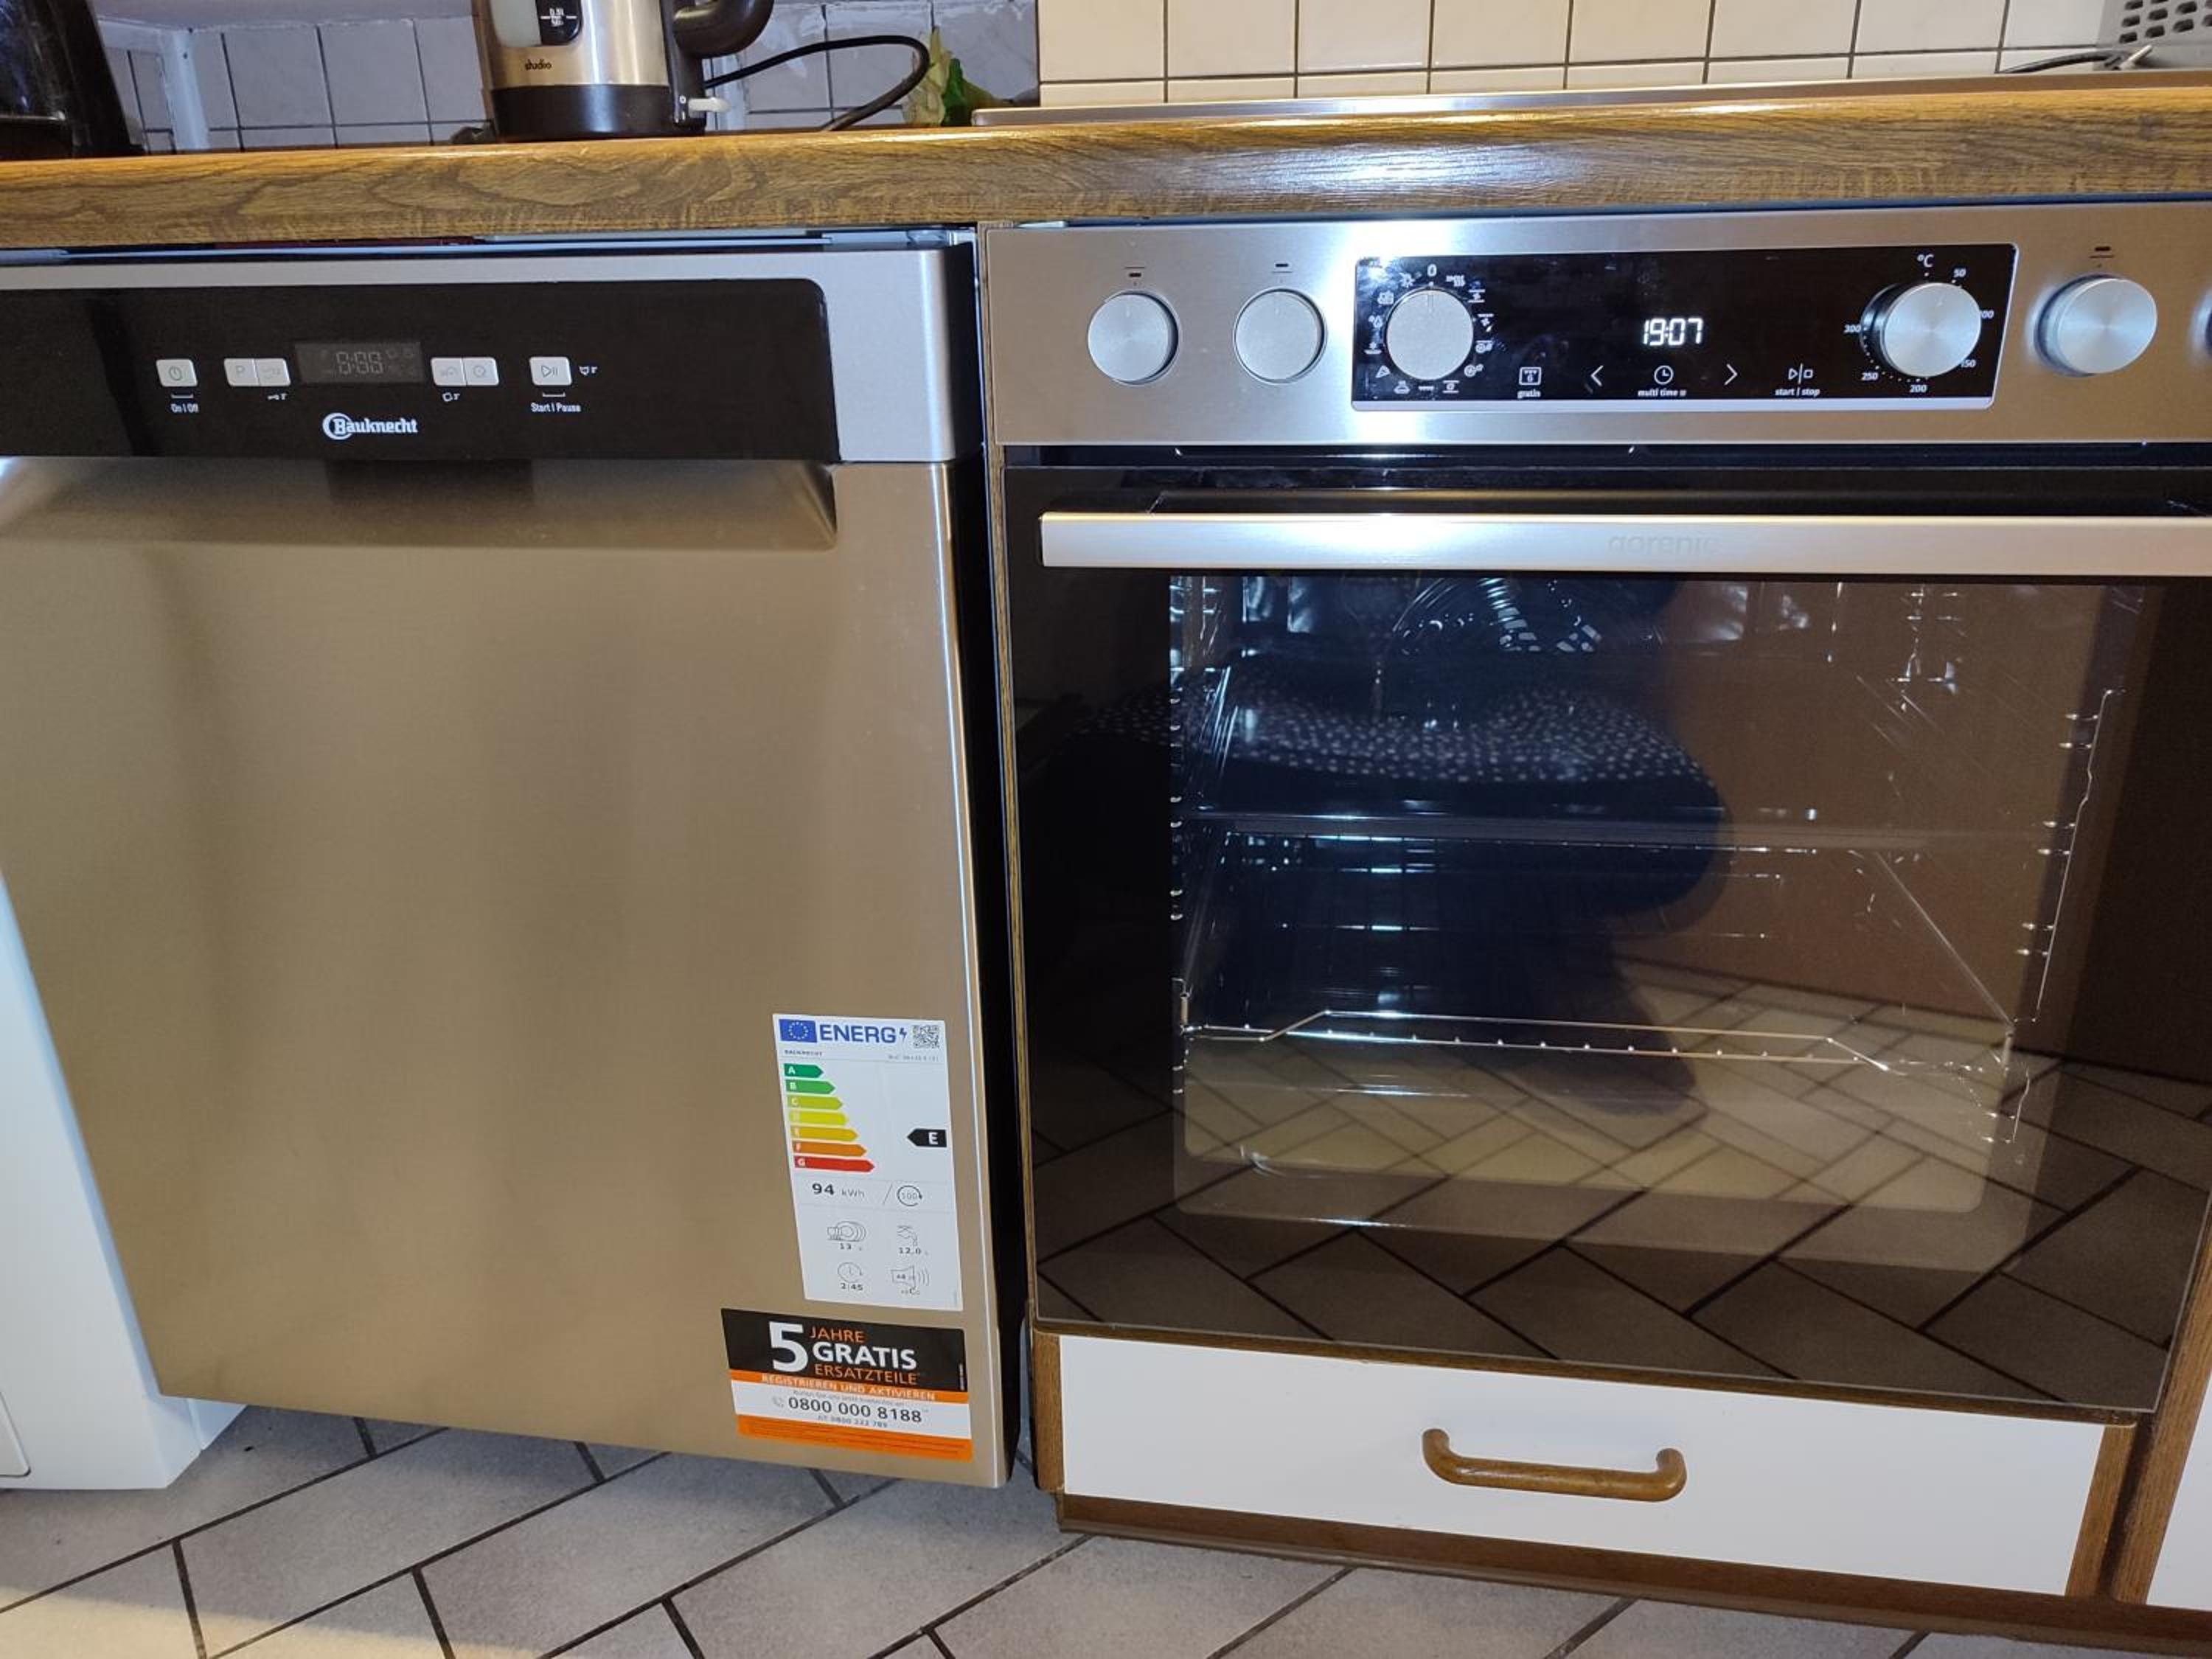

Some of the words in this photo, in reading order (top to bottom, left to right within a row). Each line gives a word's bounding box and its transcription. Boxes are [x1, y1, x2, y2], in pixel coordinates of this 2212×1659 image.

[1917, 254, 1934, 268] °C
[1427, 263, 1437, 277] 0
[1953, 268, 1966, 279] 50
[1980, 310, 1994, 319] 00
[1643, 318, 1703, 346] 19:07
[1844, 324, 1862, 333] 300
[1862, 372, 1879, 381] 250
[1517, 388, 1542, 399] gratin
[1638, 389, 1658, 397] multi
[1660, 389, 1678, 397] time
[1775, 387, 1795, 396] start
[1801, 387, 1820, 398] stop
[1910, 383, 1927, 393] 200
[530, 403, 552, 412] Start
[557, 403, 581, 412] Pause
[322, 413, 418, 440] Bauknecht
[819, 1024, 897, 1043] ENERG
[788, 1066, 796, 1075] A
[790, 1082, 797, 1091] B
[791, 1098, 799, 1107] C
[928, 1133, 939, 1144] E
[797, 1158, 806, 1166] G
[812, 1183, 835, 1195] 94
[841, 1189, 865, 1198] kWh
[810, 1326, 865, 1343] JAHRE
[769, 1321, 809, 1372] 5
[813, 1342, 917, 1370] GRATIS
[815, 1363, 917, 1385] ERSATZTEILE
[761, 1374, 838, 1391] REGISTRIEREN
[840, 1383, 866, 1394] UND
[869, 1386, 936, 1400] AKTIVIEREN
[788, 1397, 832, 1413] 0800
[838, 1403, 871, 1417] 000
[877, 1406, 922, 1423] 8188
